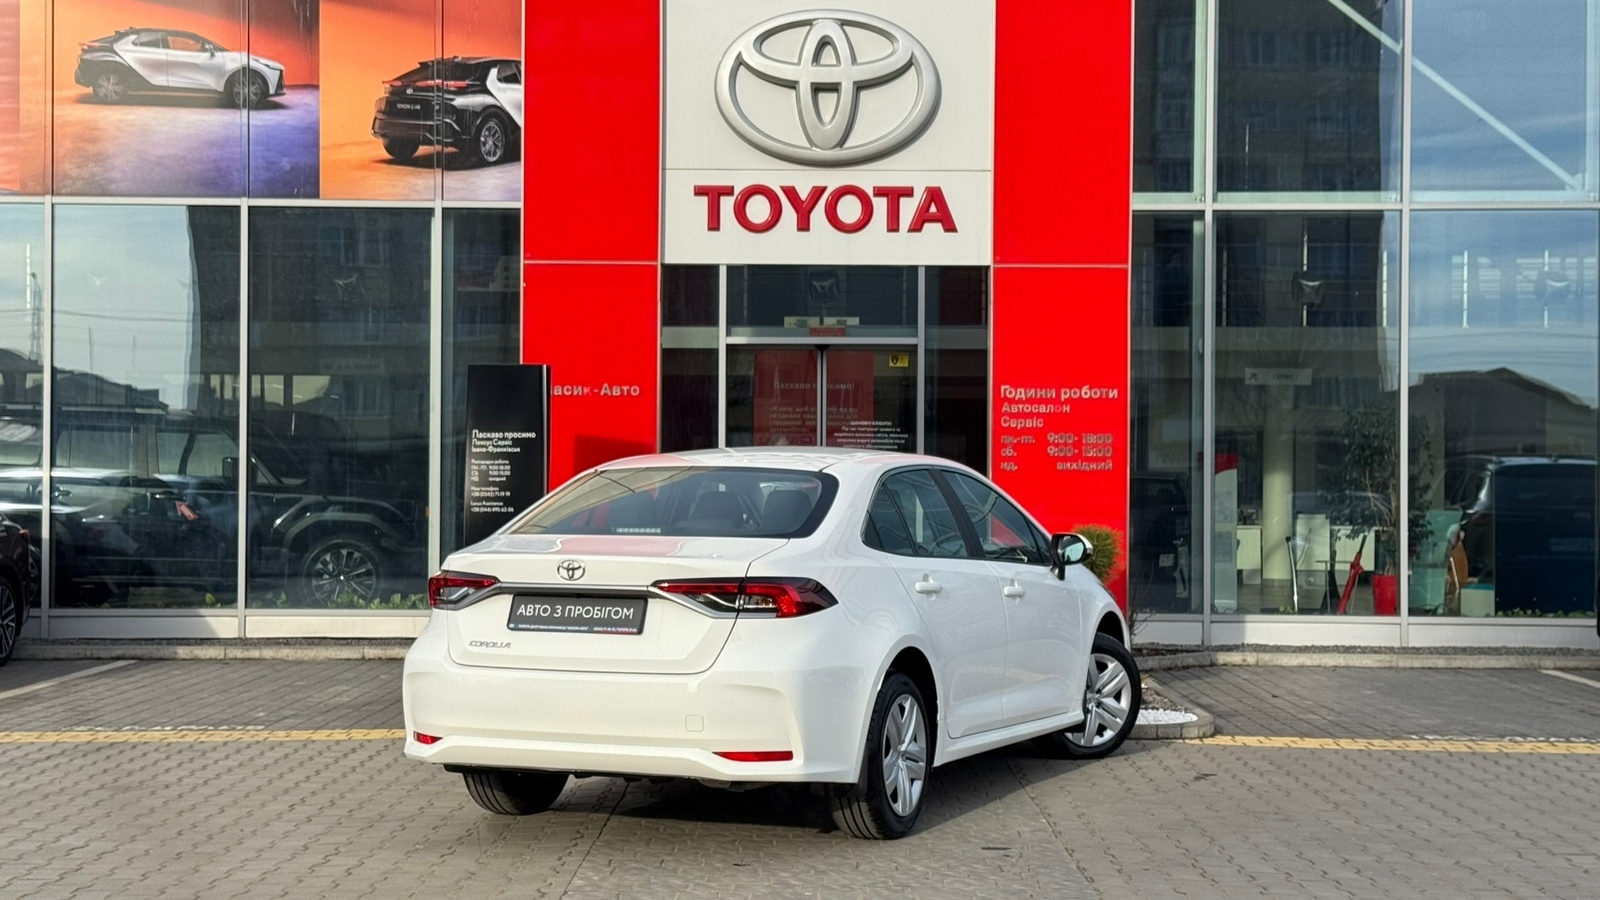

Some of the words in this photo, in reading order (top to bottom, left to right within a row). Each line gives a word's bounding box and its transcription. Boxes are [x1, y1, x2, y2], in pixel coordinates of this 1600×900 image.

[693, 184, 958, 234] TOYOTA
[550, 382, 640, 396] асик-Авто
[1000, 384, 1056, 400] Години
[1061, 384, 1118, 401] роботи
[1002, 402, 1070, 413] Автосалон
[1000, 416, 1044, 429] Сервіс
[472, 429, 503, 438] Ласкаво
[1056, 459, 1113, 471] вихідний
[516, 604, 552, 618] АВТО
[564, 605, 634, 620] ПРОБІГОМ
[469, 640, 511, 649] COROLLA
